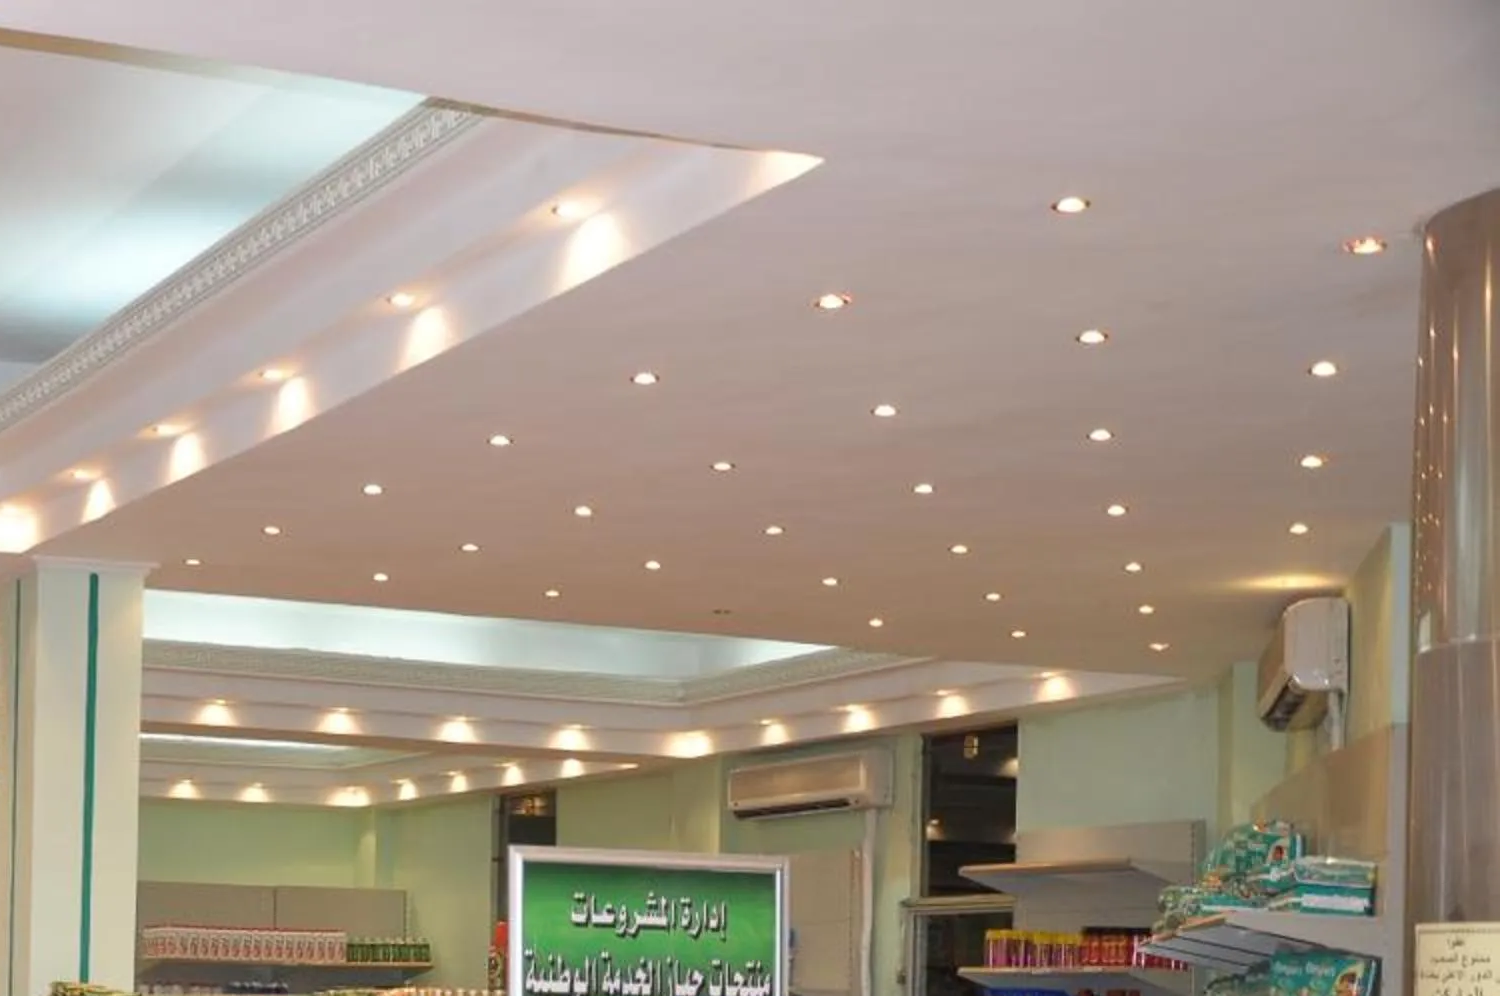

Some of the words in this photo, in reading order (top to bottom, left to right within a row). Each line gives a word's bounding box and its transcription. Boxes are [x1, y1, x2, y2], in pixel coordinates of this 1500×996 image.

[571, 890, 675, 935] المشروعات
[679, 896, 726, 940] إدارة
[601, 950, 661, 996] الخدمة
